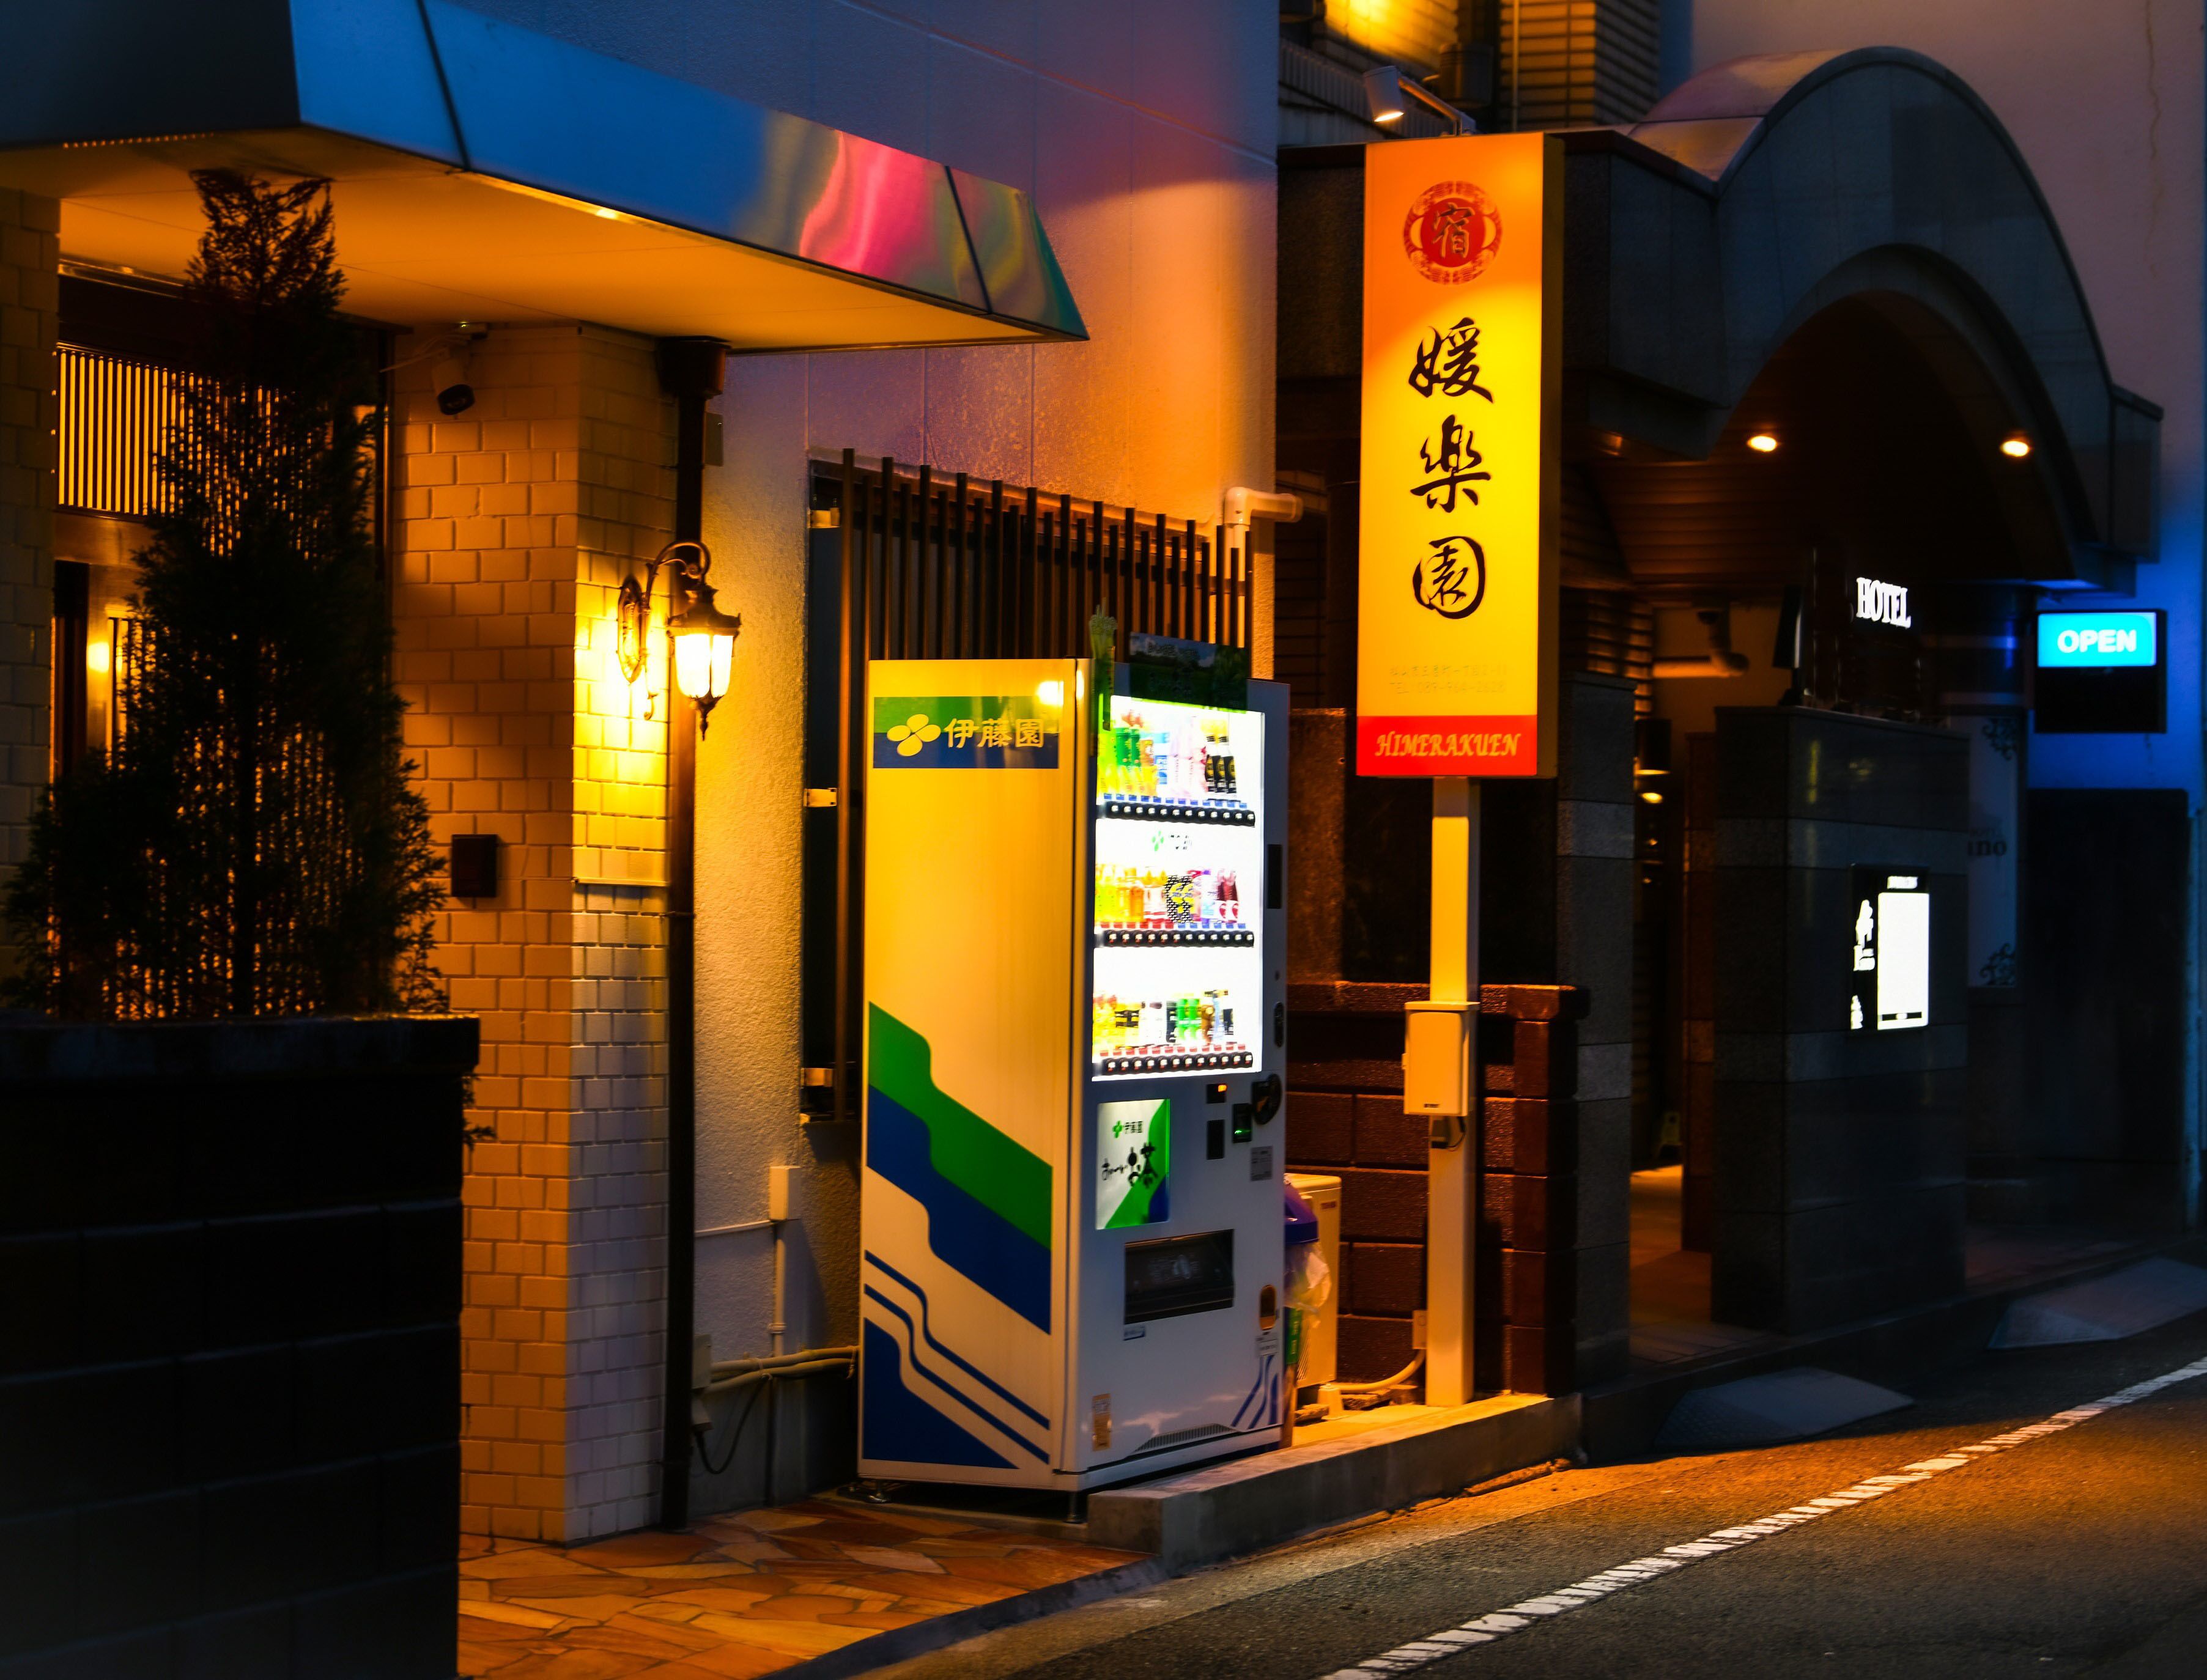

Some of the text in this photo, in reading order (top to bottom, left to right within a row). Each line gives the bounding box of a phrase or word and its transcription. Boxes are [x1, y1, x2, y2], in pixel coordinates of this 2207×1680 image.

[1855, 577, 1912, 629] HOTEL
[2057, 629, 2137, 653] OPEN
[944, 718, 1044, 749] 伊藤園
[1374, 731, 1521, 757] HIMERAKUEN
